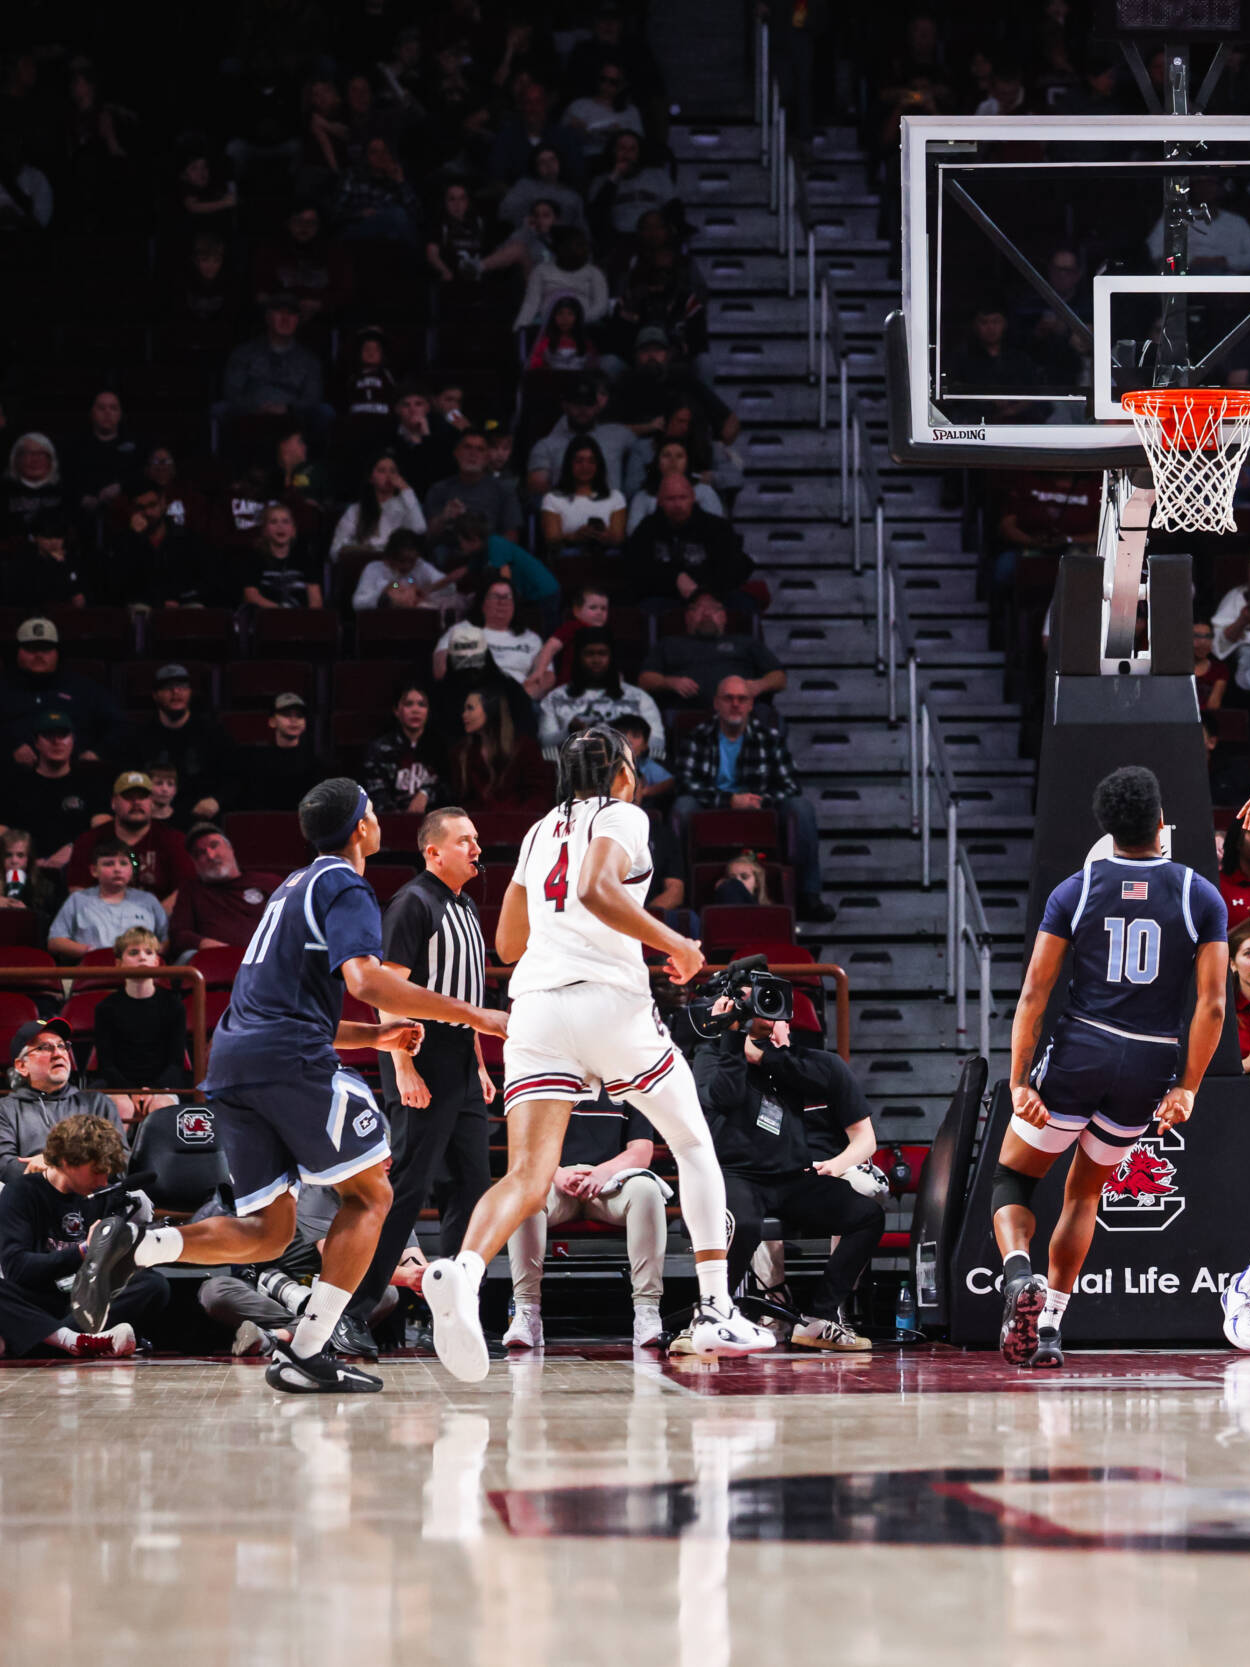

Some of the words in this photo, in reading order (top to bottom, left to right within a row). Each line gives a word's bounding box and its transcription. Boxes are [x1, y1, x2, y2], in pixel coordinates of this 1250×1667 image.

[932, 428, 986, 441] SPALDING
[544, 841, 569, 912] 4
[1104, 917, 1162, 984] 10
[1124, 1266, 1180, 1294] Life
